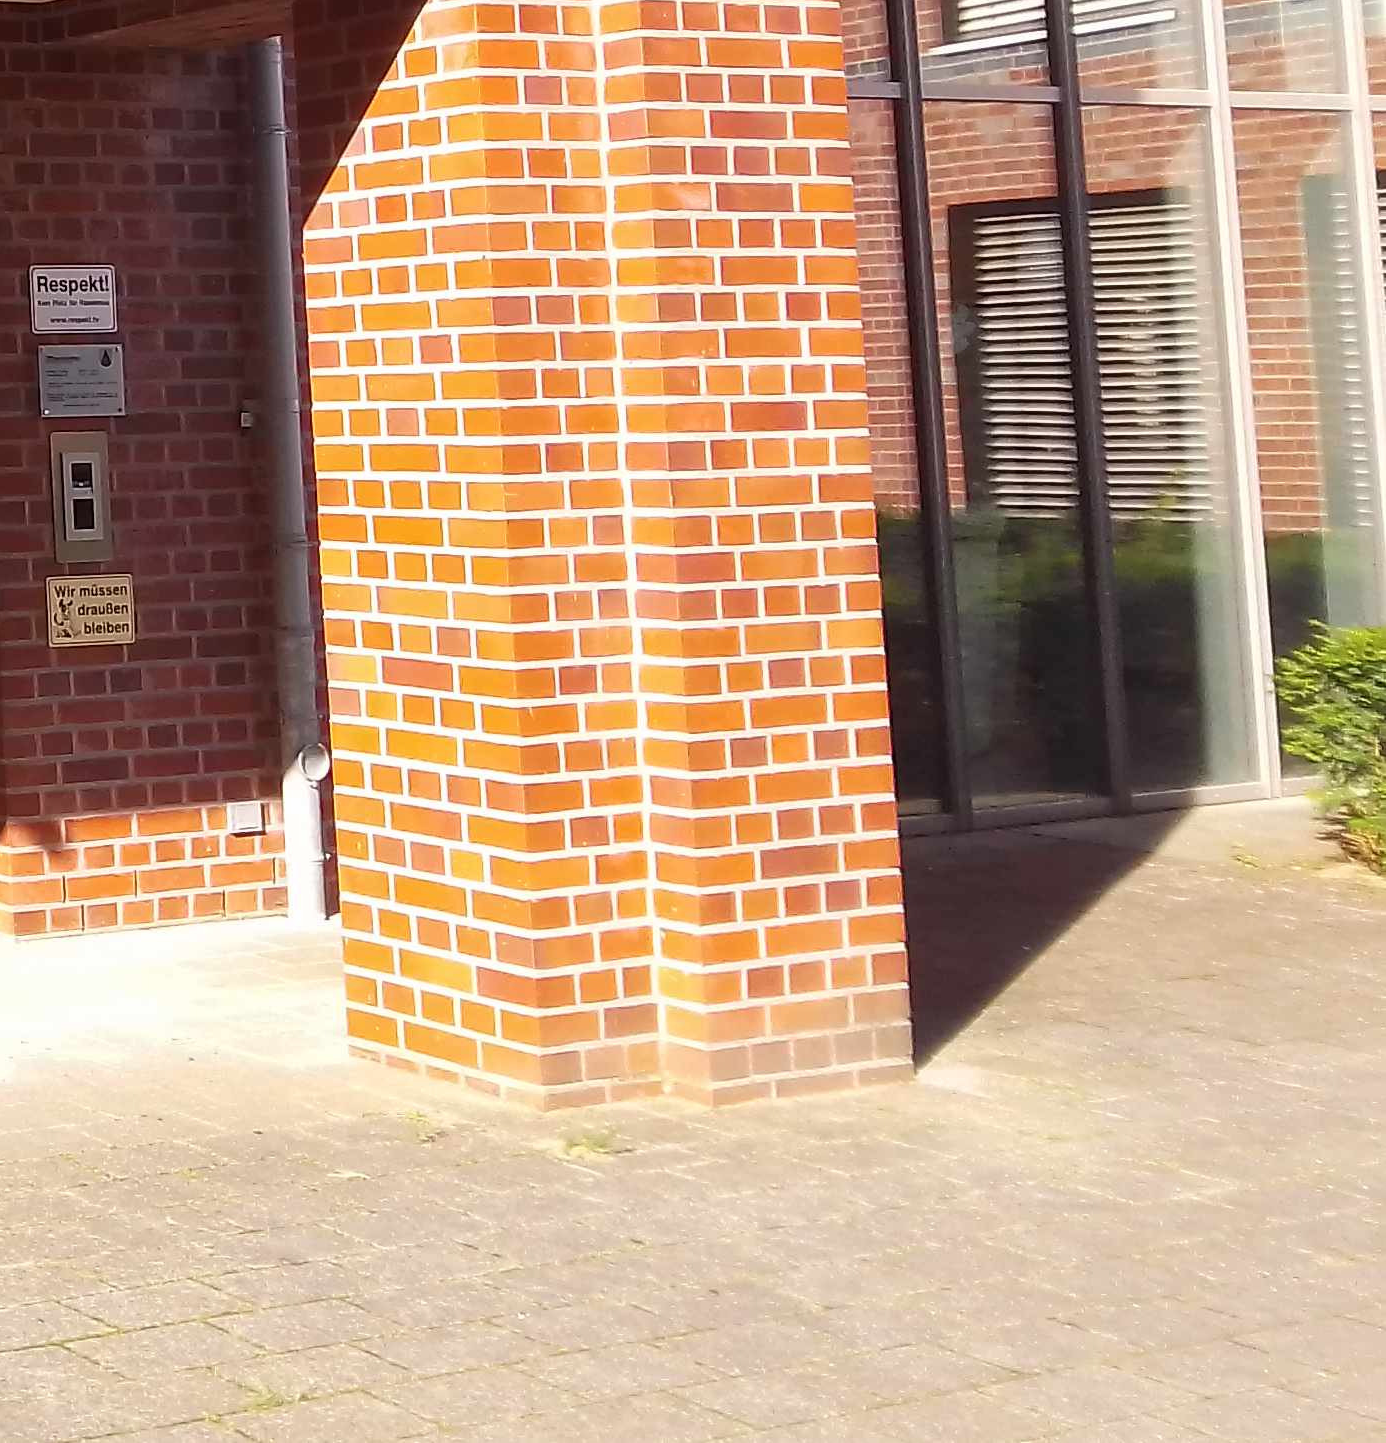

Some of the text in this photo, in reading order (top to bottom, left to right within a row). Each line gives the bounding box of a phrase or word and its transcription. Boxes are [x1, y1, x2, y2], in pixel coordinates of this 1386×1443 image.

[36, 274, 110, 296] Respekt!
[54, 584, 128, 598] Wir müssen
[78, 603, 129, 615] draußen
[84, 621, 130, 634] bleiben
